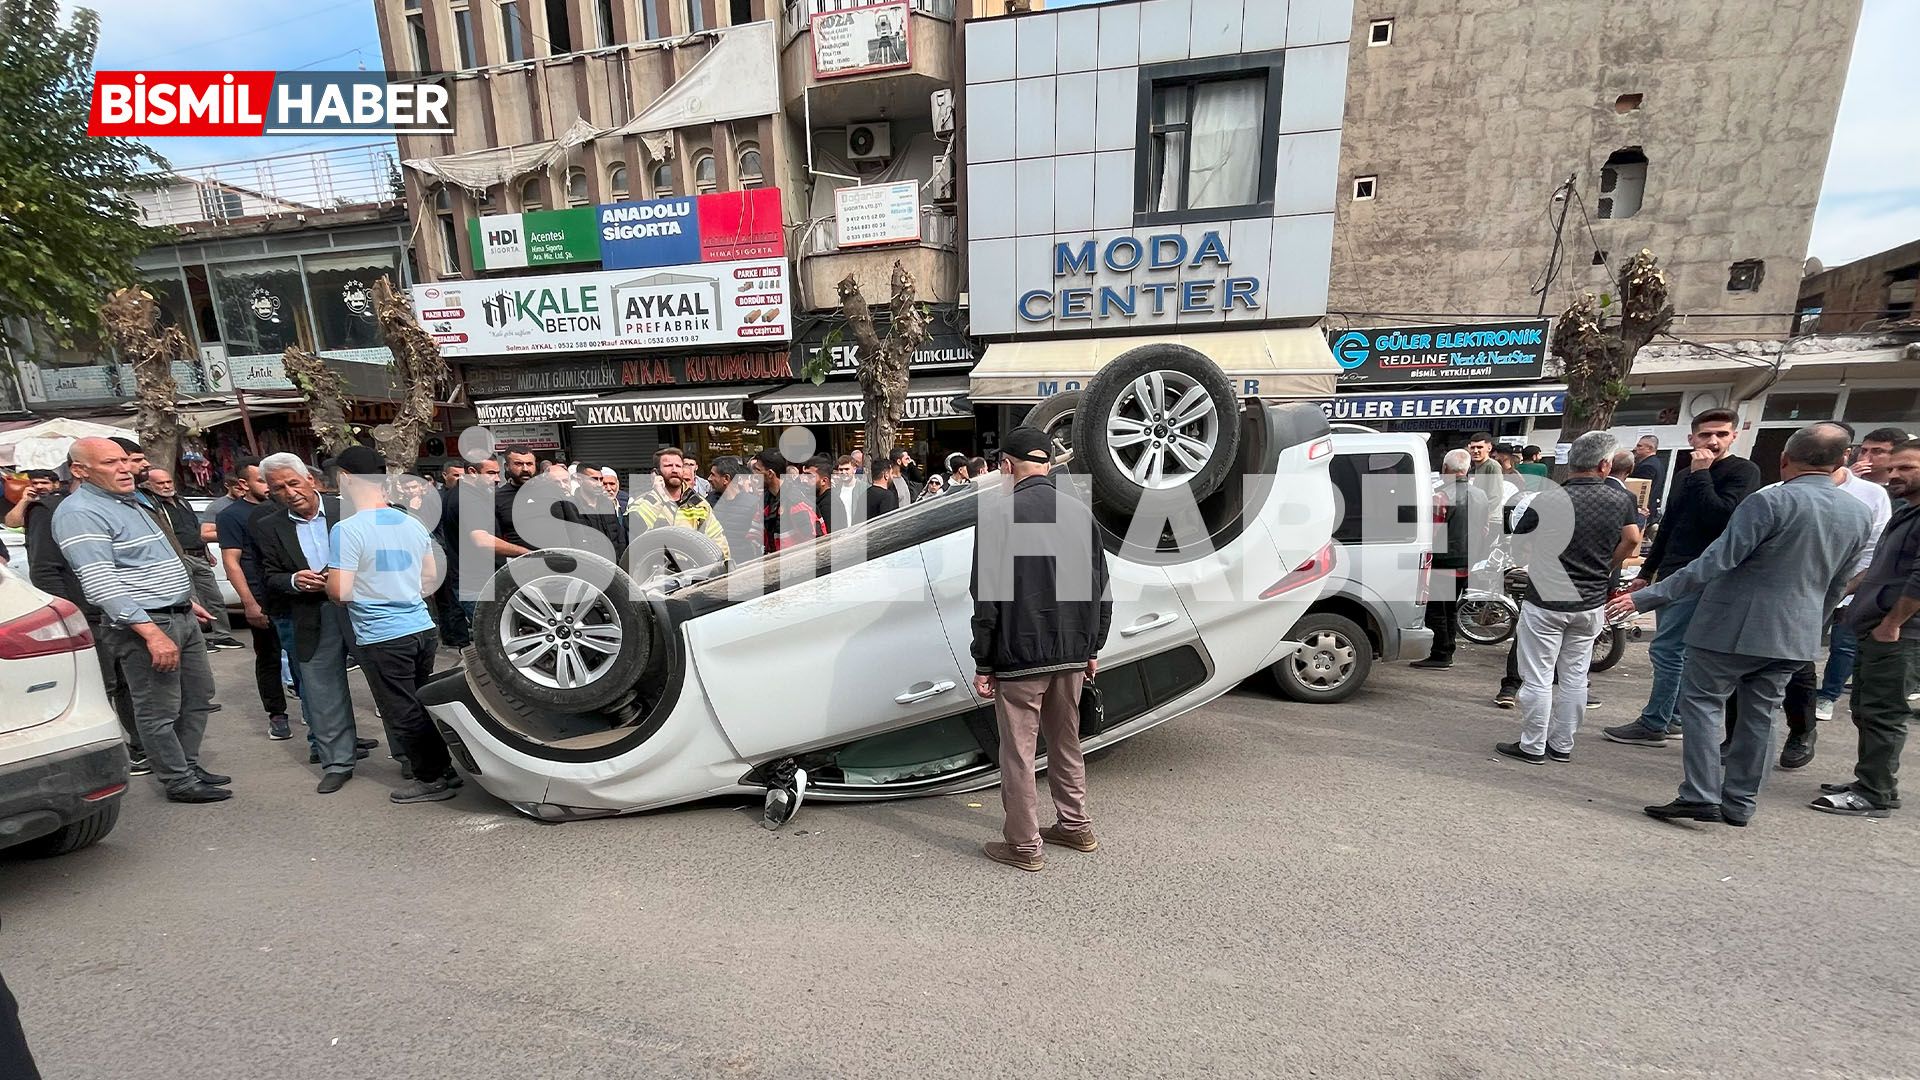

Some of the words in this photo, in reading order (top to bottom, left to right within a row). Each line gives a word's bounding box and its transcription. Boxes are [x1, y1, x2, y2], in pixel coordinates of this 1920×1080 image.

[602, 202, 690, 223] ANADOLU
[488, 229, 518, 246] HDI
[530, 229, 565, 243] Acentesi
[602, 221, 681, 241] SİGORTA
[1054, 230, 1232, 276] MODA
[737, 269, 758, 278] PARKE
[762, 267, 779, 277] BİMS
[514, 285, 599, 332] KALE
[625, 292, 709, 319] AYKAL
[740, 295, 766, 305] BORDÜR
[1018, 276, 1261, 323] CENTER
[546, 315, 601, 333] BETON
[626, 316, 710, 334] PREFABRİK
[1375, 331, 1431, 351] GÜLER
[1435, 328, 1543, 349] ELEKTRONİK
[621, 358, 677, 386] AYKAL
[684, 351, 794, 383] KUYUMCULUK
[1380, 353, 1448, 366] REDLINE
[517, 372, 550, 391] MİDYAT
[1410, 368, 1437, 378] BİSMİL
[1440, 367, 1470, 377] YETKİLİ
[477, 404, 514, 419] MİDYAT
[587, 404, 631, 424] AYKAL
[632, 401, 729, 422] KUYUMCULUK
[770, 400, 825, 423] TEKİN
[1319, 398, 1394, 419] GÜLER
[1400, 392, 1558, 417] ELEKTRONİK
